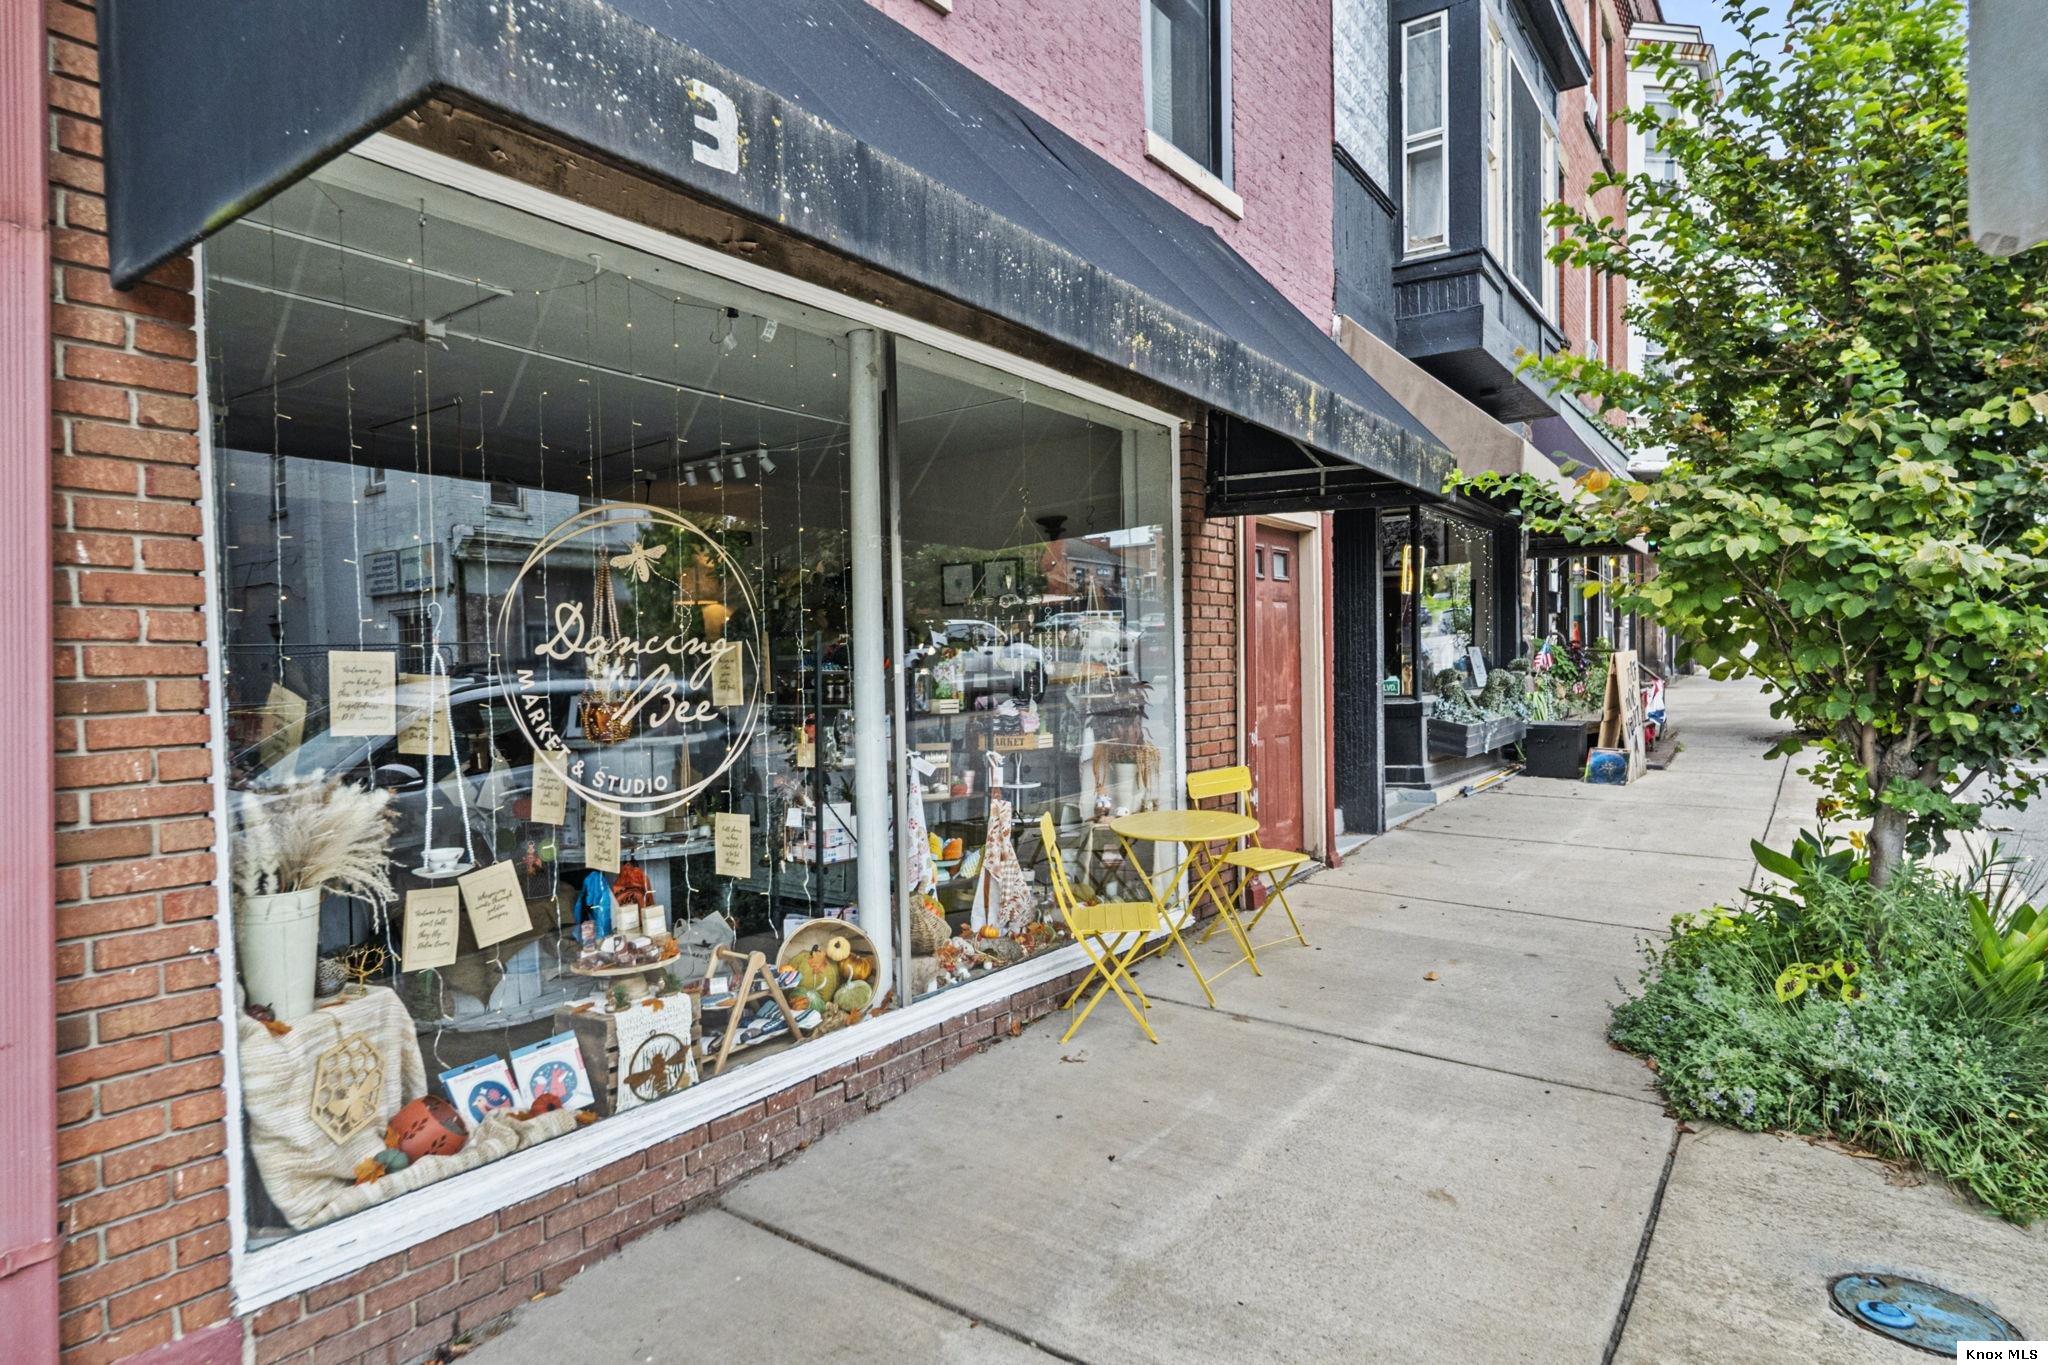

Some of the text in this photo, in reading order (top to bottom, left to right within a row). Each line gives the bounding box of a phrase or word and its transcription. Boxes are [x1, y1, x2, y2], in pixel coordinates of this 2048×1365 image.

[692, 79, 740, 174] 3
[535, 602, 736, 691] Dancing
[516, 669, 668, 795] MARKET & STUDIO
[611, 663, 719, 728] Bee
[993, 737, 1025, 747] ARKET
